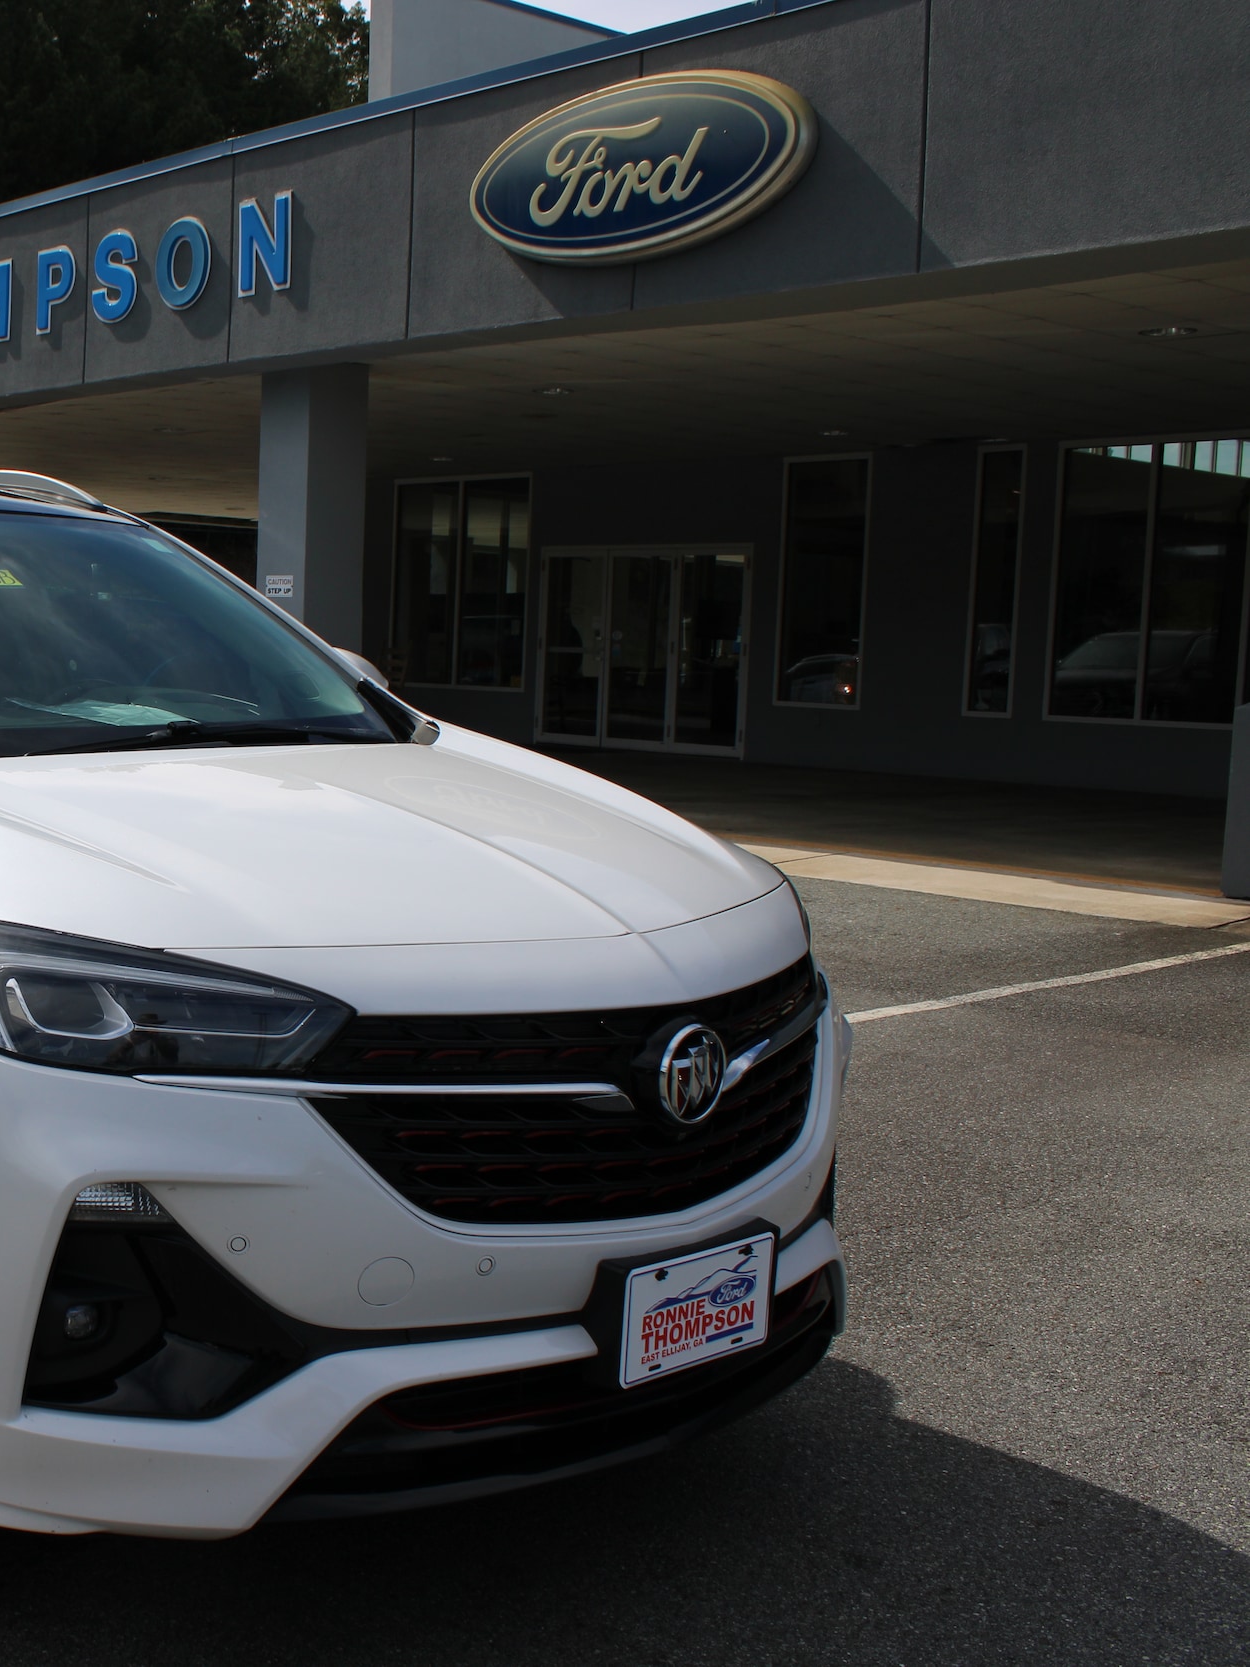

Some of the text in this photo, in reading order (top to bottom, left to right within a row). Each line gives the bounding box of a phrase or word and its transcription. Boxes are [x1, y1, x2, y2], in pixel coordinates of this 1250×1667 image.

[529, 116, 710, 228] Ford
[267, 587, 292, 595] STEP UP
[716, 1281, 748, 1304] Ford
[641, 1300, 755, 1354] THOMPSON
[642, 1298, 707, 1333] RONNIE
[641, 1338, 704, 1365] EAST ELLIJAY, GA
